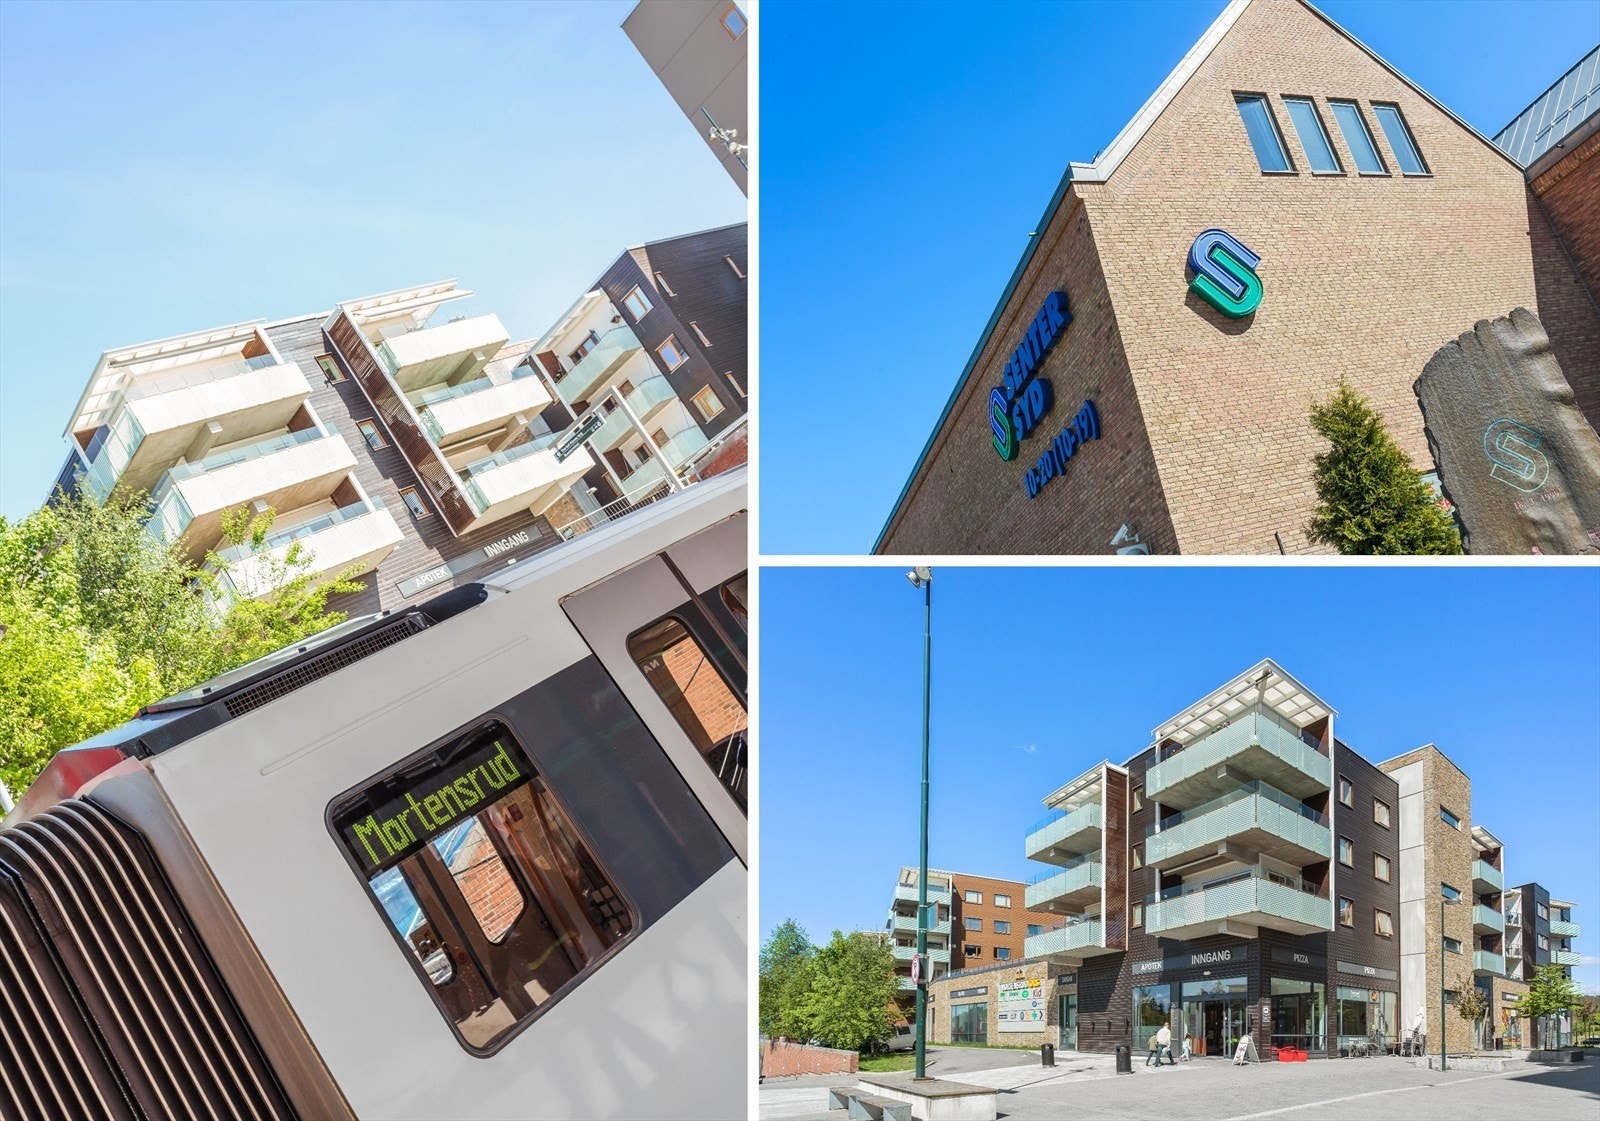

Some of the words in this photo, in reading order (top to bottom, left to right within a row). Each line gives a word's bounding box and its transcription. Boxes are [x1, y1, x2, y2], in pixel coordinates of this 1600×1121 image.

[1003, 291, 1072, 400] SENTER
[1012, 378, 1053, 441] SYD
[1024, 450, 1055, 499] 10-20
[1053, 400, 1100, 476] (10-19)
[415, 567, 449, 588] APOTEK
[483, 531, 529, 558] INNGANG
[352, 741, 521, 865] Mortensrud
[1141, 961, 1162, 971] APOTEK
[1191, 949, 1231, 965] INNGANG
[1293, 953, 1309, 964] PIZZA
